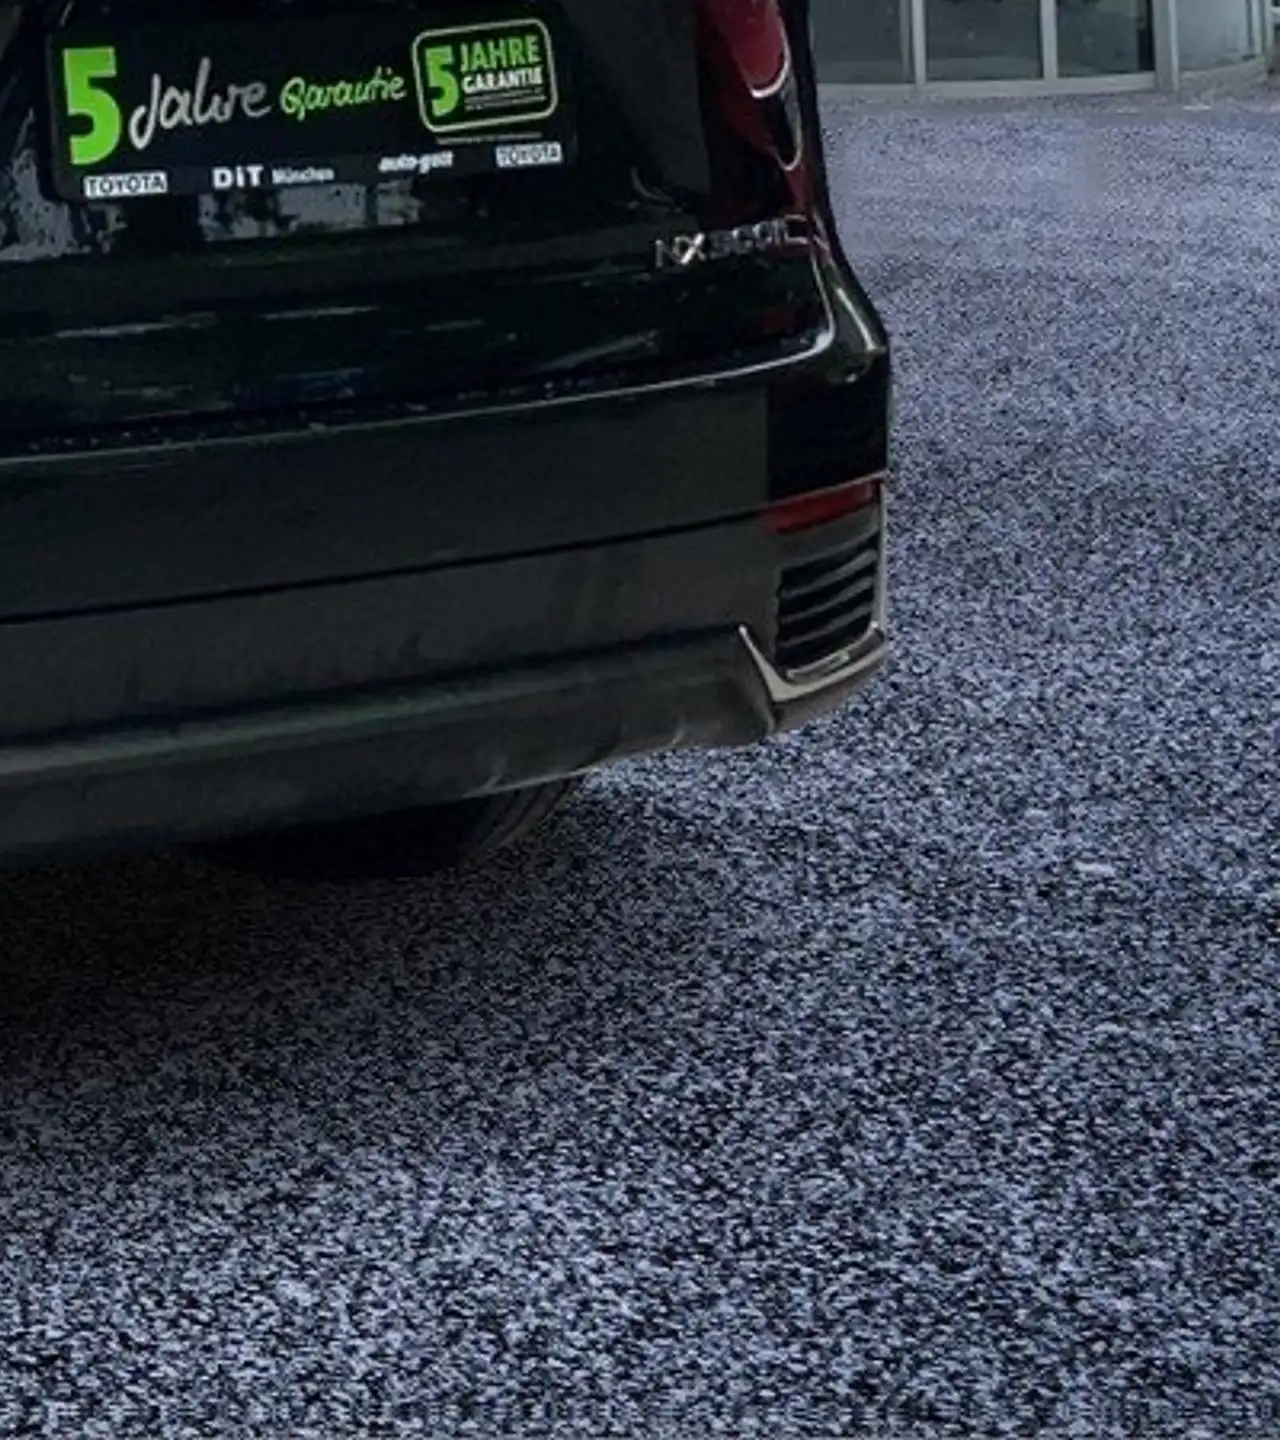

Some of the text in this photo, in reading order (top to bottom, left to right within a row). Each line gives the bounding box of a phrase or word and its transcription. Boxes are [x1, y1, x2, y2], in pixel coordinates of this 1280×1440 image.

[460, 34, 541, 73] JAHRE
[425, 44, 460, 117] 5
[461, 64, 544, 95] GARANTIE
[62, 47, 122, 165] 5
[128, 57, 273, 150] Jahre
[83, 171, 168, 198] TOYOTA
